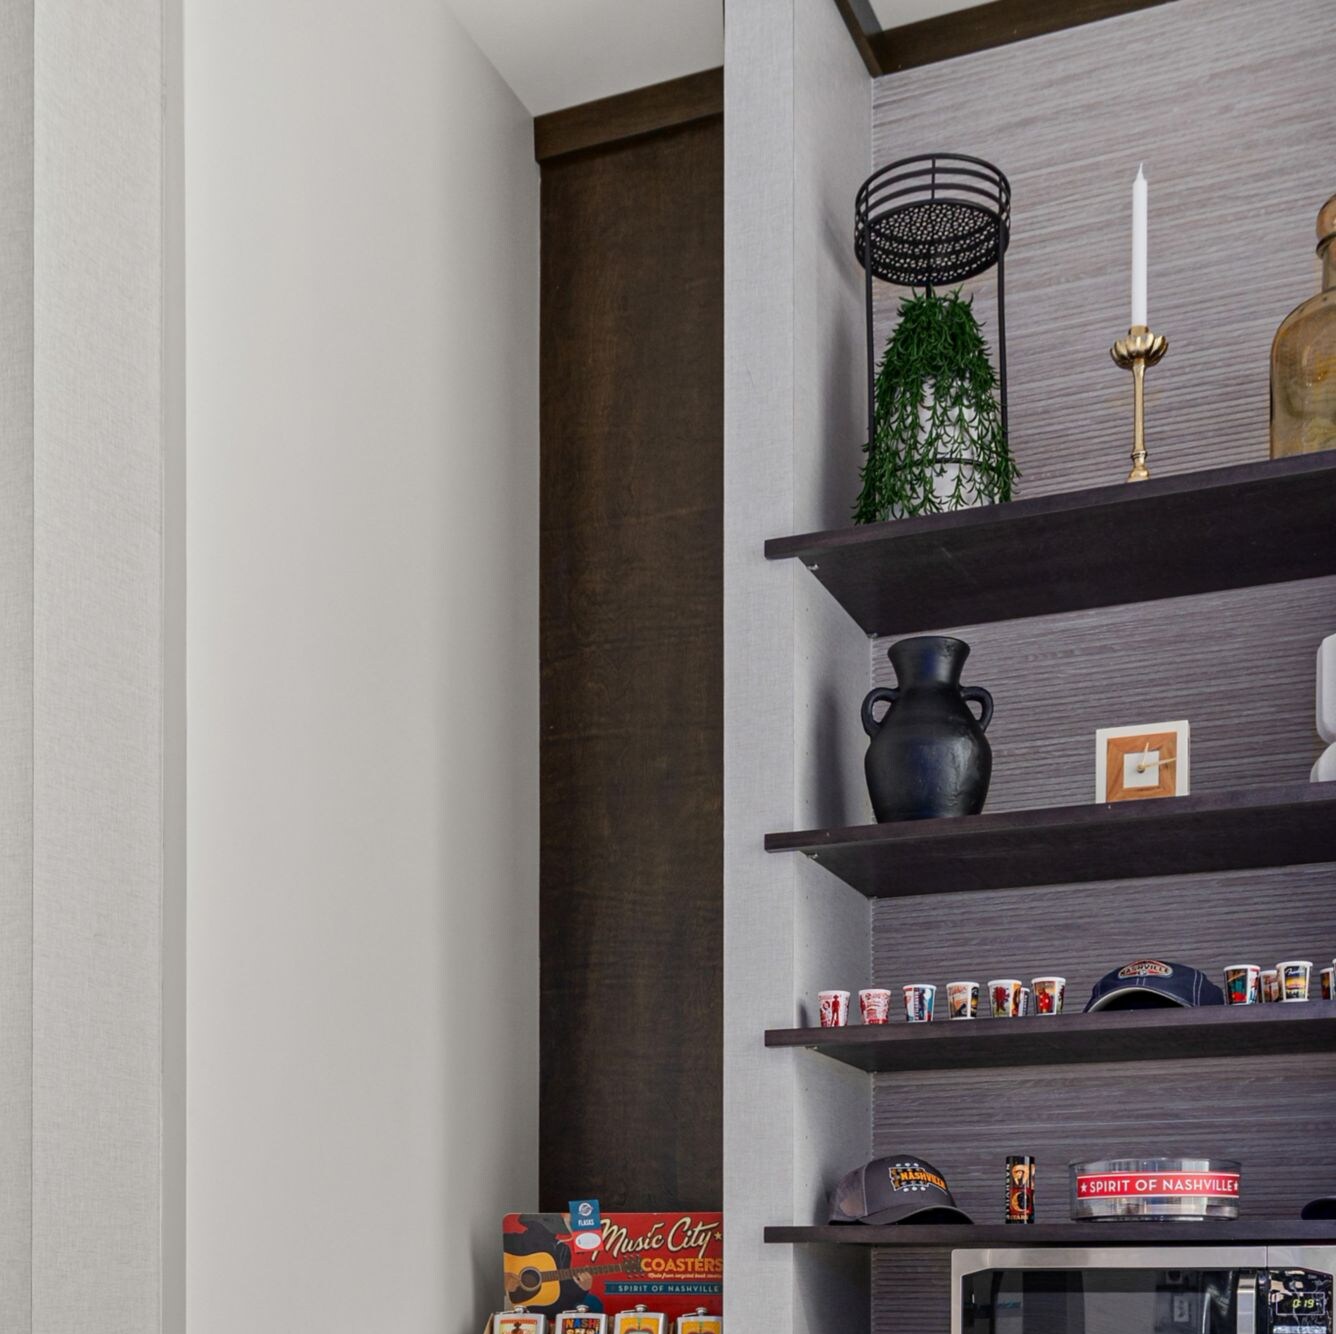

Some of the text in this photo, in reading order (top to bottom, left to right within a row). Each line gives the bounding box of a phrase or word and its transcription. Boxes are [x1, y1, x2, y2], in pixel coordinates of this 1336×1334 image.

[1089, 1178, 1233, 1194] SPIRIT OF NASHVILLE
[591, 1216, 720, 1262] Music City
[640, 1257, 723, 1272] COASTERS
[618, 1285, 648, 1293] SPIRIT
[668, 1285, 719, 1293] NASHVILLE
